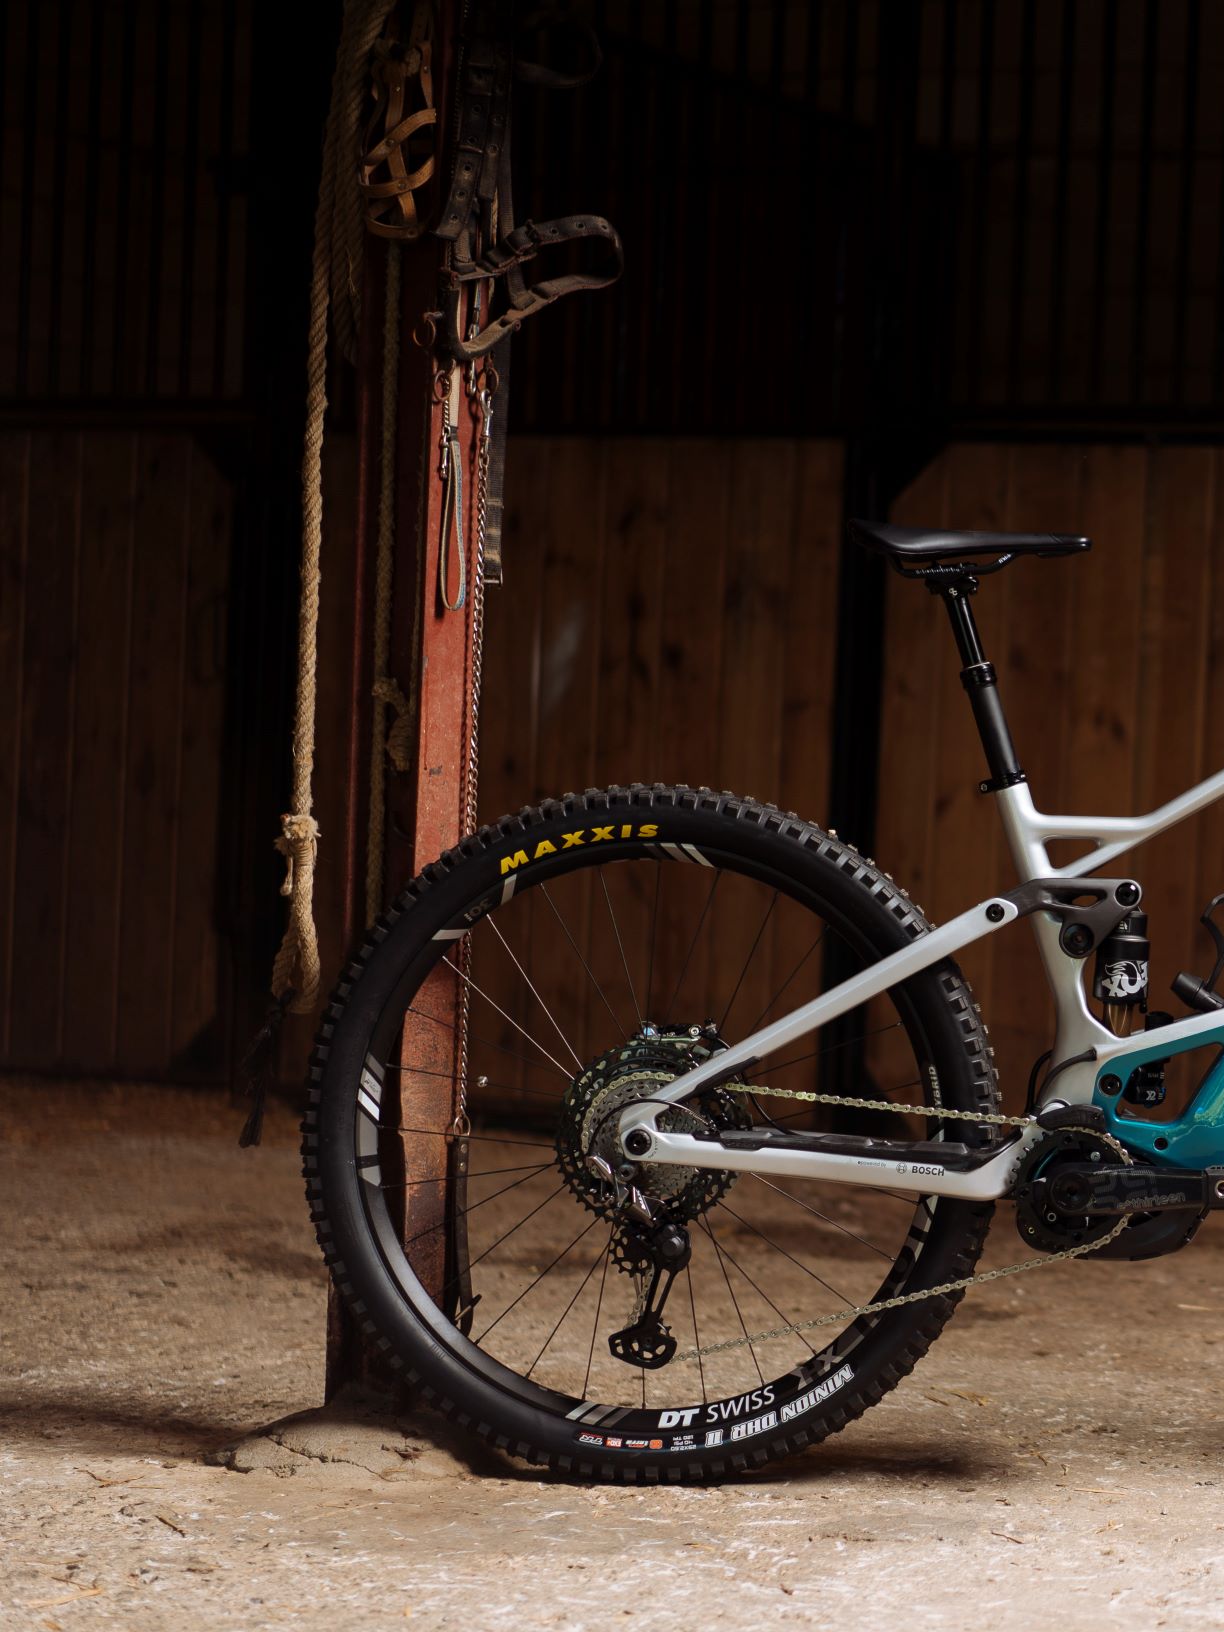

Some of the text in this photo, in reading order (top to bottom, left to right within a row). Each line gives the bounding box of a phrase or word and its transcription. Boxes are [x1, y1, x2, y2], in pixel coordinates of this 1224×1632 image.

[501, 824, 659, 874] MAXXIS
[928, 1065, 943, 1108] YBRID
[911, 1165, 945, 1176] BOSCH
[658, 1408, 700, 1428] DT
[706, 1385, 775, 1423] SWISS
[780, 1363, 855, 1423] MINION
[730, 1411, 778, 1442] DHR
